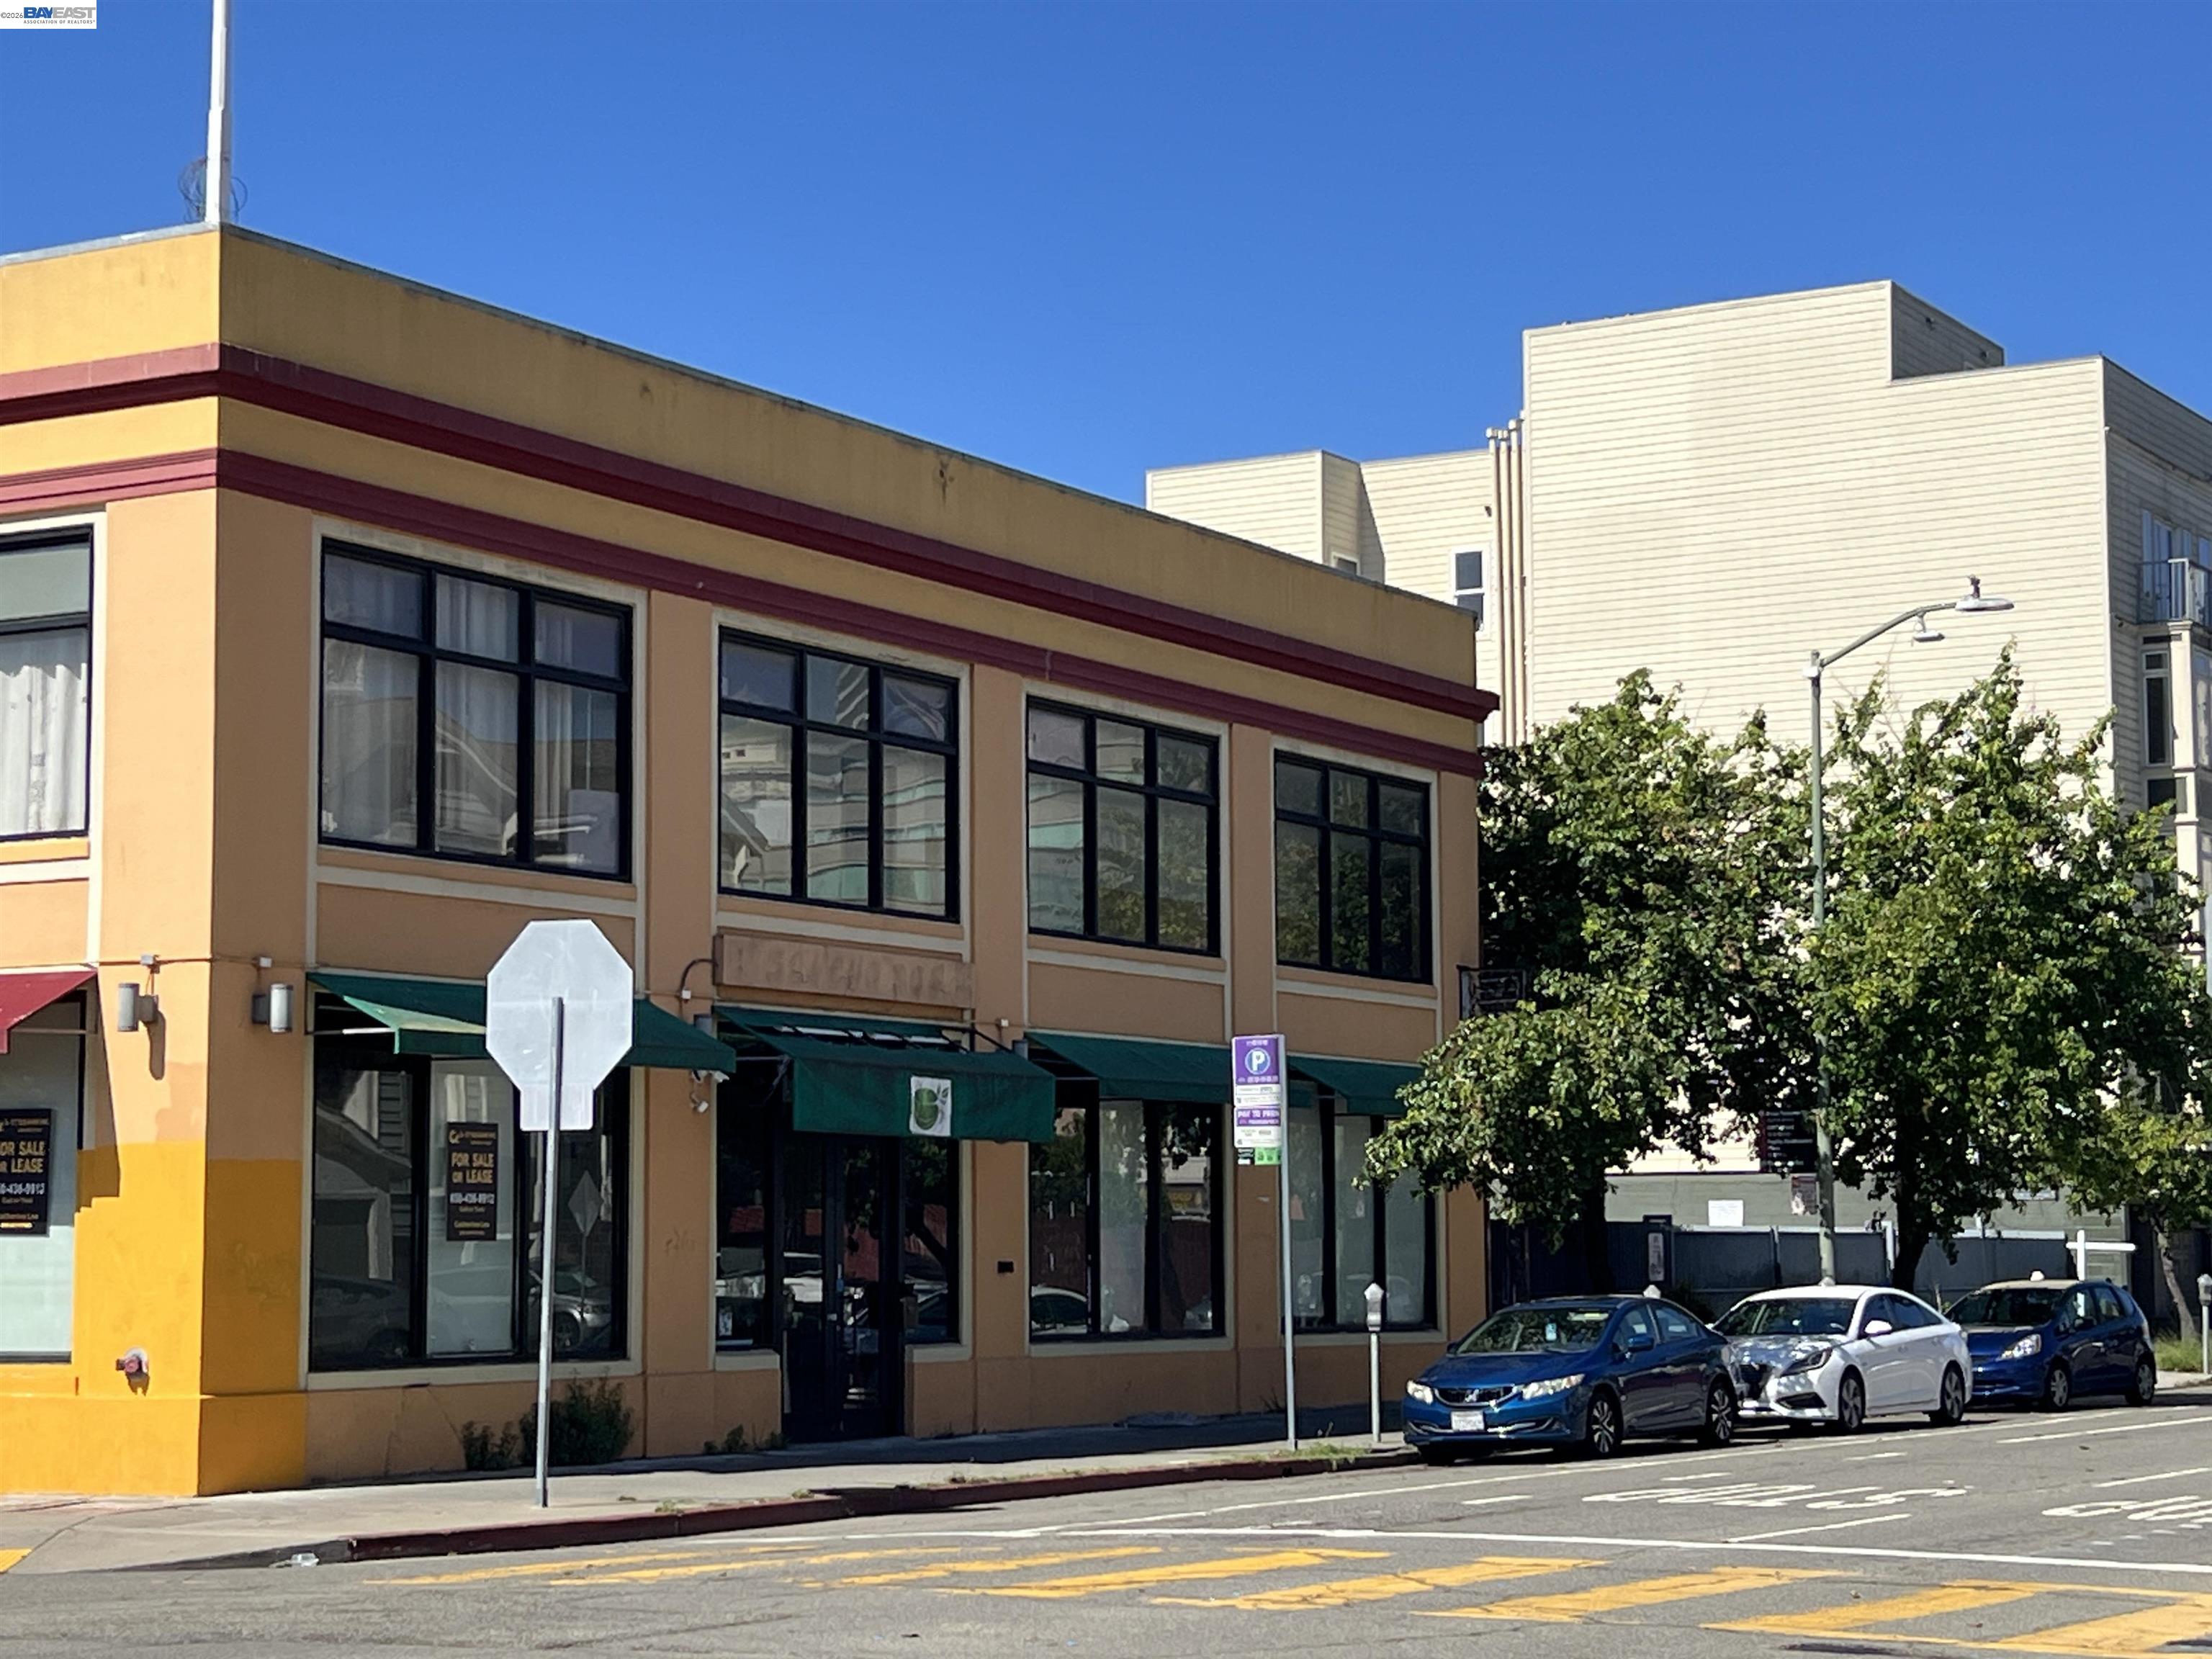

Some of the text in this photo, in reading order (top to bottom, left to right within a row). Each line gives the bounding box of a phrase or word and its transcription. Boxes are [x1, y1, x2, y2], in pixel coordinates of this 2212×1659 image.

[0, 1141, 45, 1156] OR SALE
[11, 1158, 44, 1173] LEASE
[472, 1153, 495, 1168] SALE
[466, 1169, 493, 1184] LEASE
